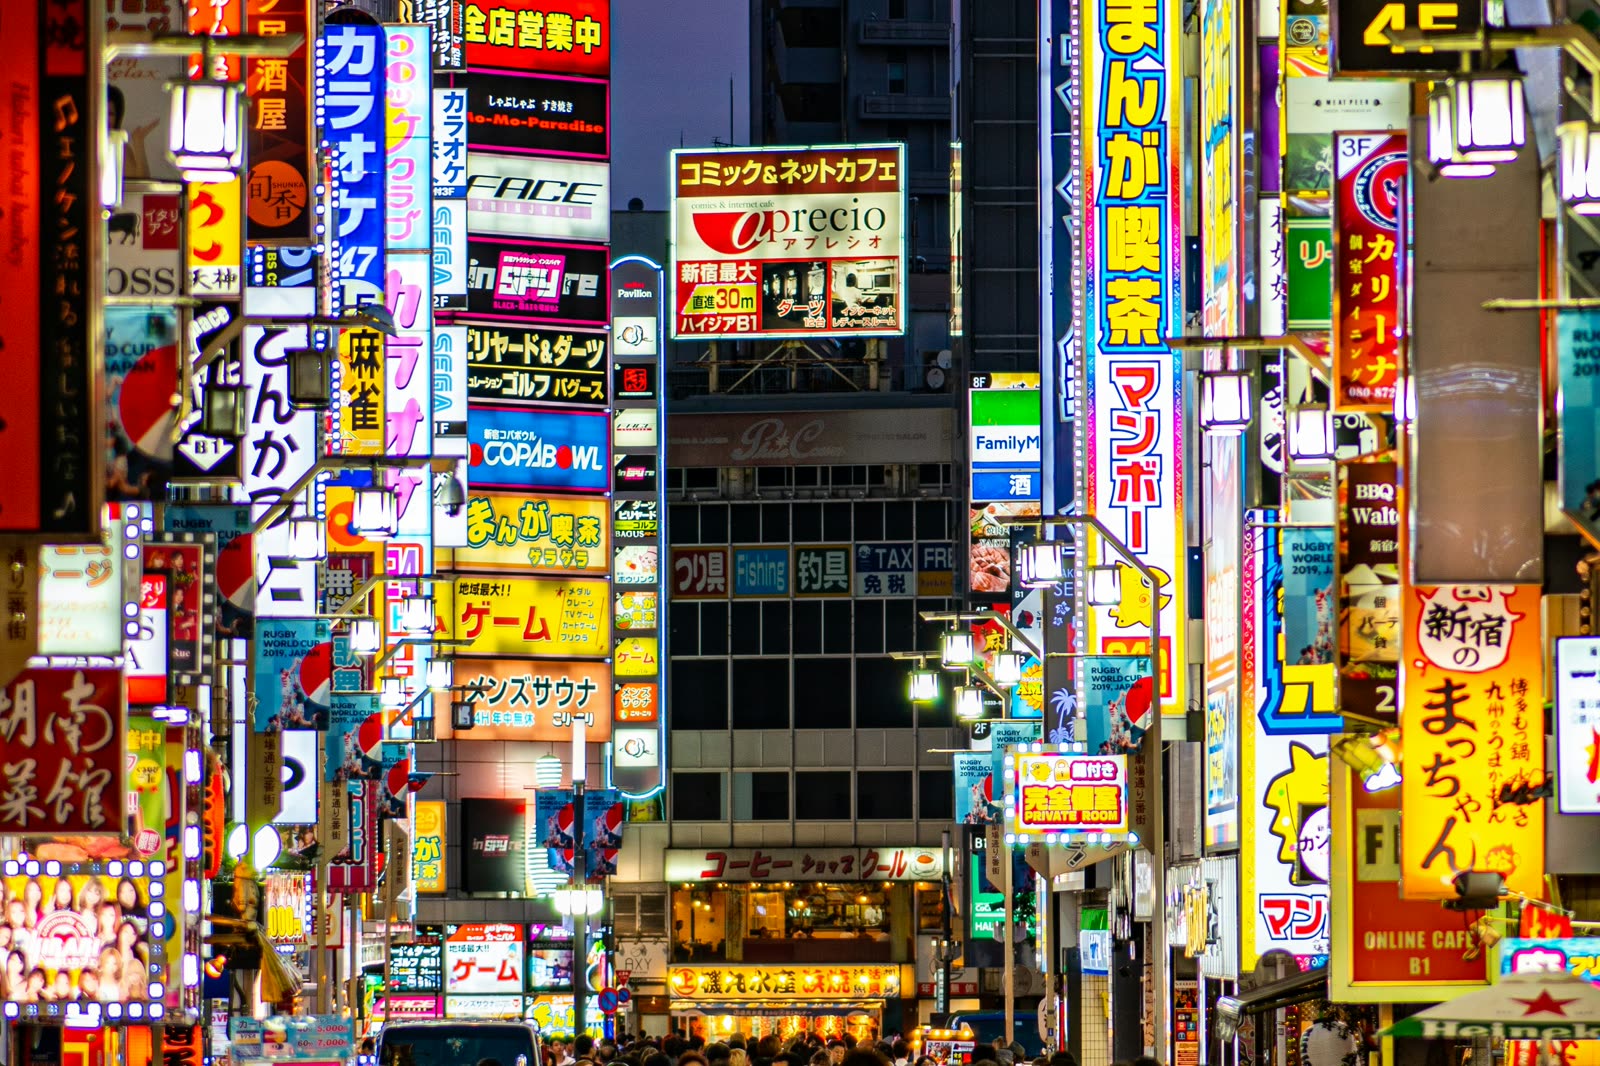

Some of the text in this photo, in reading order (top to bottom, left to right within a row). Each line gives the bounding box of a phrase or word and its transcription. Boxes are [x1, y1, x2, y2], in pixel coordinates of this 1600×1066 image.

[466, 4, 601, 54] 全店営業中
[488, 94, 574, 113] しゃぶしゃぶ すき焼き
[325, 26, 377, 238] カラオケ
[443, 92, 465, 185] カラオケ
[1342, 138, 1372, 157] 3F
[680, 156, 897, 187] コミック&ネットカフェ
[272, 181, 305, 189] SHUNKA
[467, 174, 603, 205] FACE
[691, 200, 718, 210] comics
[727, 199, 759, 209] internet
[759, 199, 775, 208] cafe
[731, 197, 887, 249] aprecio
[433, 206, 453, 287] SEGA
[783, 235, 884, 251] アプレシオ
[338, 246, 378, 279] 47
[681, 261, 758, 284] 新宿最大
[433, 296, 449, 308] 2F
[618, 289, 652, 300] Pavilion
[692, 286, 755, 311] 直進30m
[776, 299, 825, 317] ダーツ
[1364, 233, 1398, 385] カリーナ
[680, 314, 758, 333] ハイジアB1
[348, 329, 381, 431] 麻雀
[434, 333, 453, 413] SEGA
[973, 376, 986, 388] 8F
[502, 371, 551, 398] ゴルフ
[554, 378, 605, 400] バグース
[434, 422, 449, 434] 1F
[483, 428, 537, 442] 新宿コパボウル
[194, 440, 219, 454] B1
[1115, 367, 1157, 549] マンボー
[1009, 473, 1032, 496] 酒
[1356, 484, 1395, 501] BBQ
[173, 520, 213, 529] RUGBY
[467, 497, 600, 547] まんが喫茶
[1292, 542, 1332, 552] RUGBY
[528, 547, 590, 568] ゲラゲラ
[874, 547, 914, 569] TAX
[674, 550, 725, 592] つり具
[737, 552, 786, 592] Fishing
[798, 550, 850, 592] 釣具
[458, 583, 513, 598] 地域最大!!
[864, 573, 907, 595] 免税
[565, 598, 595, 608] クレーン
[1014, 591, 1024, 599] B1
[460, 599, 552, 643] ゲーム
[1424, 603, 1508, 649] 新宿
[263, 630, 303, 644] RUGBY
[263, 640, 326, 648] WORLD CUP
[263, 649, 326, 659] 2019, JAPAN
[617, 650, 656, 665] ゲーム
[1453, 647, 1480, 668] の
[1091, 666, 1121, 674] RUGBY
[1091, 674, 1143, 683] WORLD CUP
[466, 674, 598, 709] メンズサウナ
[621, 687, 652, 698] メンズ
[1091, 683, 1143, 692] 2019, JAPAN
[621, 697, 652, 708] サウナ
[974, 722, 987, 734] 2F
[1420, 678, 1483, 876] まっちゃん
[1023, 785, 1119, 811] 完全個室
[1024, 810, 1119, 822] PRIVATE ROOM
[1364, 930, 1427, 950] ONLINE
[452, 955, 519, 982] ゲーム
[1410, 957, 1431, 976] B1
[699, 968, 797, 995] 磯丸水産
[921, 982, 975, 994] 年無休
